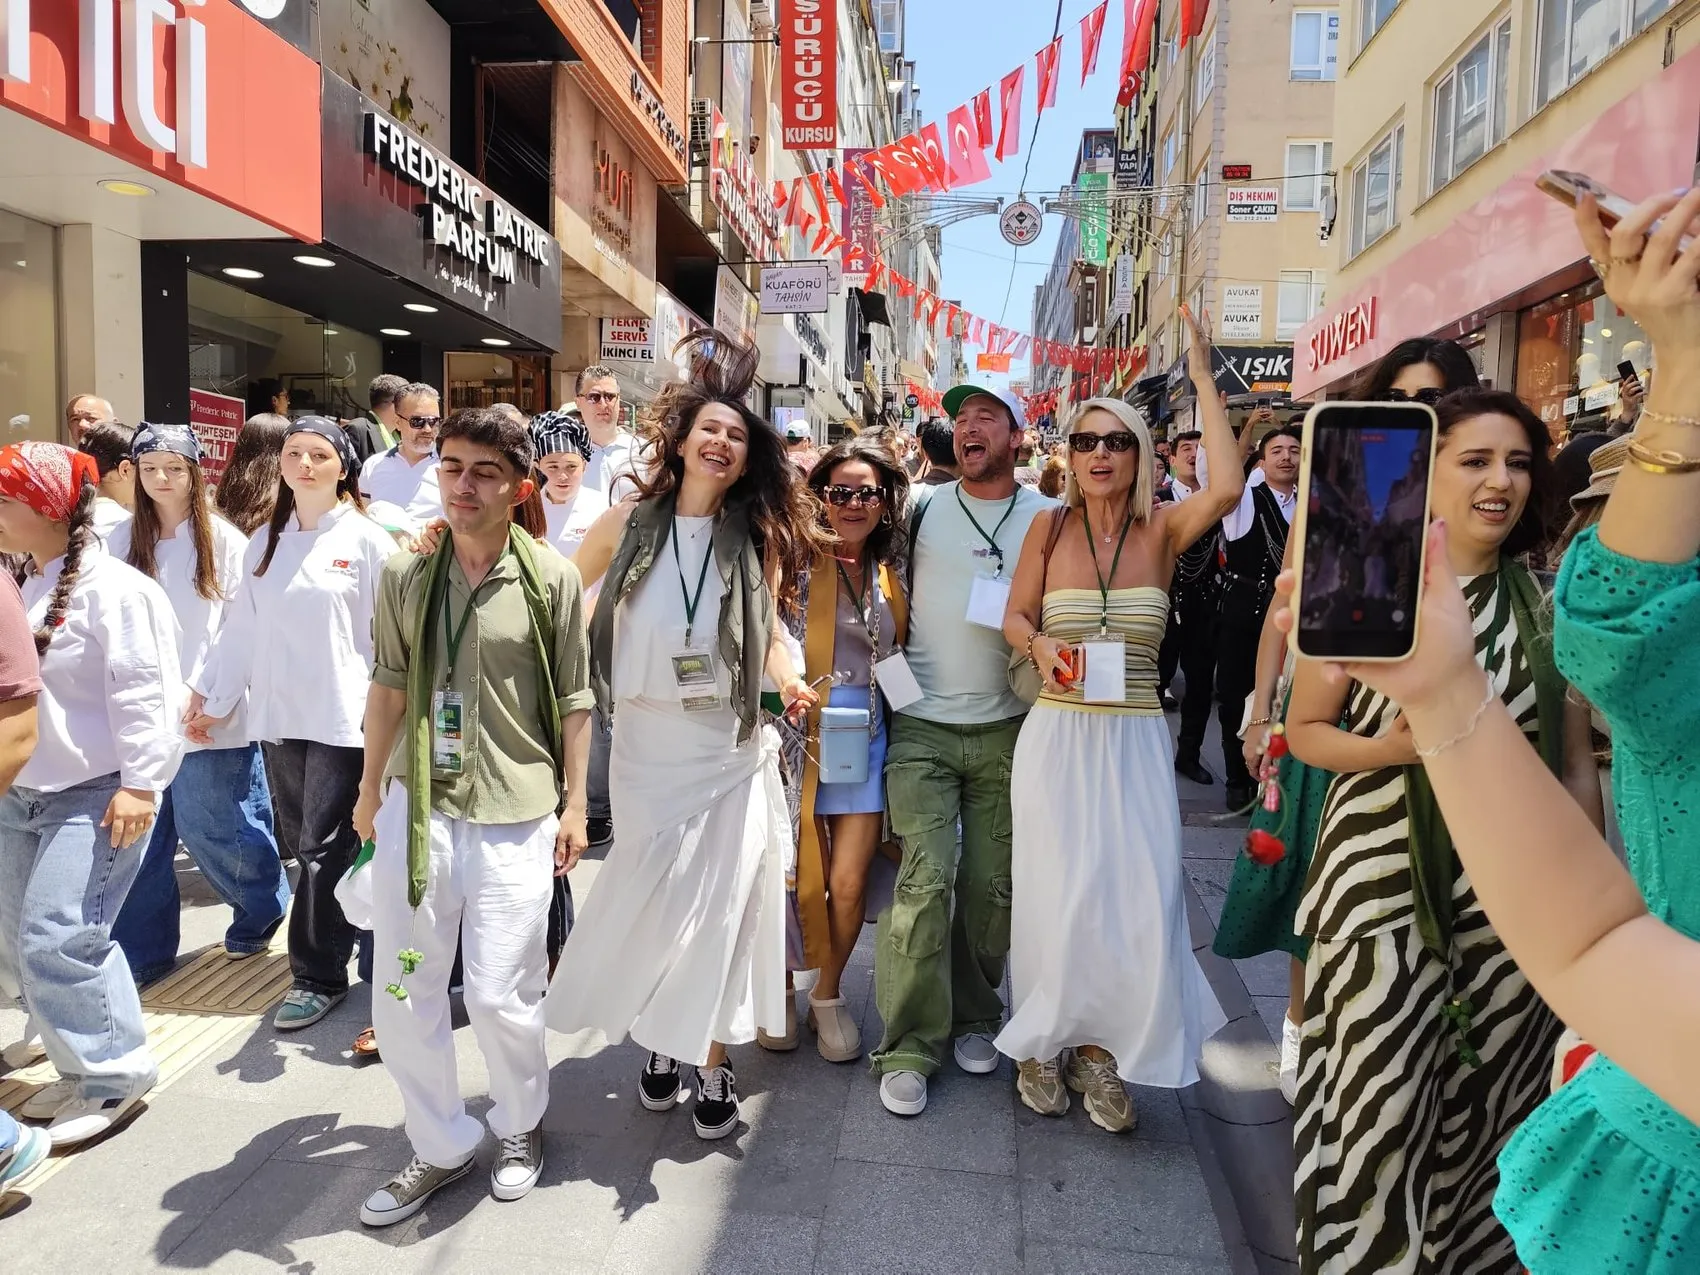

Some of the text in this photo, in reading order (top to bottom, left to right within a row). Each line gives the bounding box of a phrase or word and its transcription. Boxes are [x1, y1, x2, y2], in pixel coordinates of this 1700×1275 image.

[785, 127, 834, 143] KURSU
[1120, 153, 1137, 161] ELA
[1119, 162, 1138, 170] YAPI
[374, 112, 484, 222] FREDERIC
[493, 200, 549, 266] PATRIC
[1229, 205, 1251, 214] Soner
[432, 203, 516, 284] PARFUM
[765, 277, 822, 290] KUAFÖRÜ
[775, 290, 812, 303] TAHSİN
[1226, 288, 1260, 297] AVUKAT
[1224, 314, 1260, 323] AVUKAT
[1308, 296, 1376, 372] SUWEN
[602, 344, 654, 360] İKİNCİ EL
